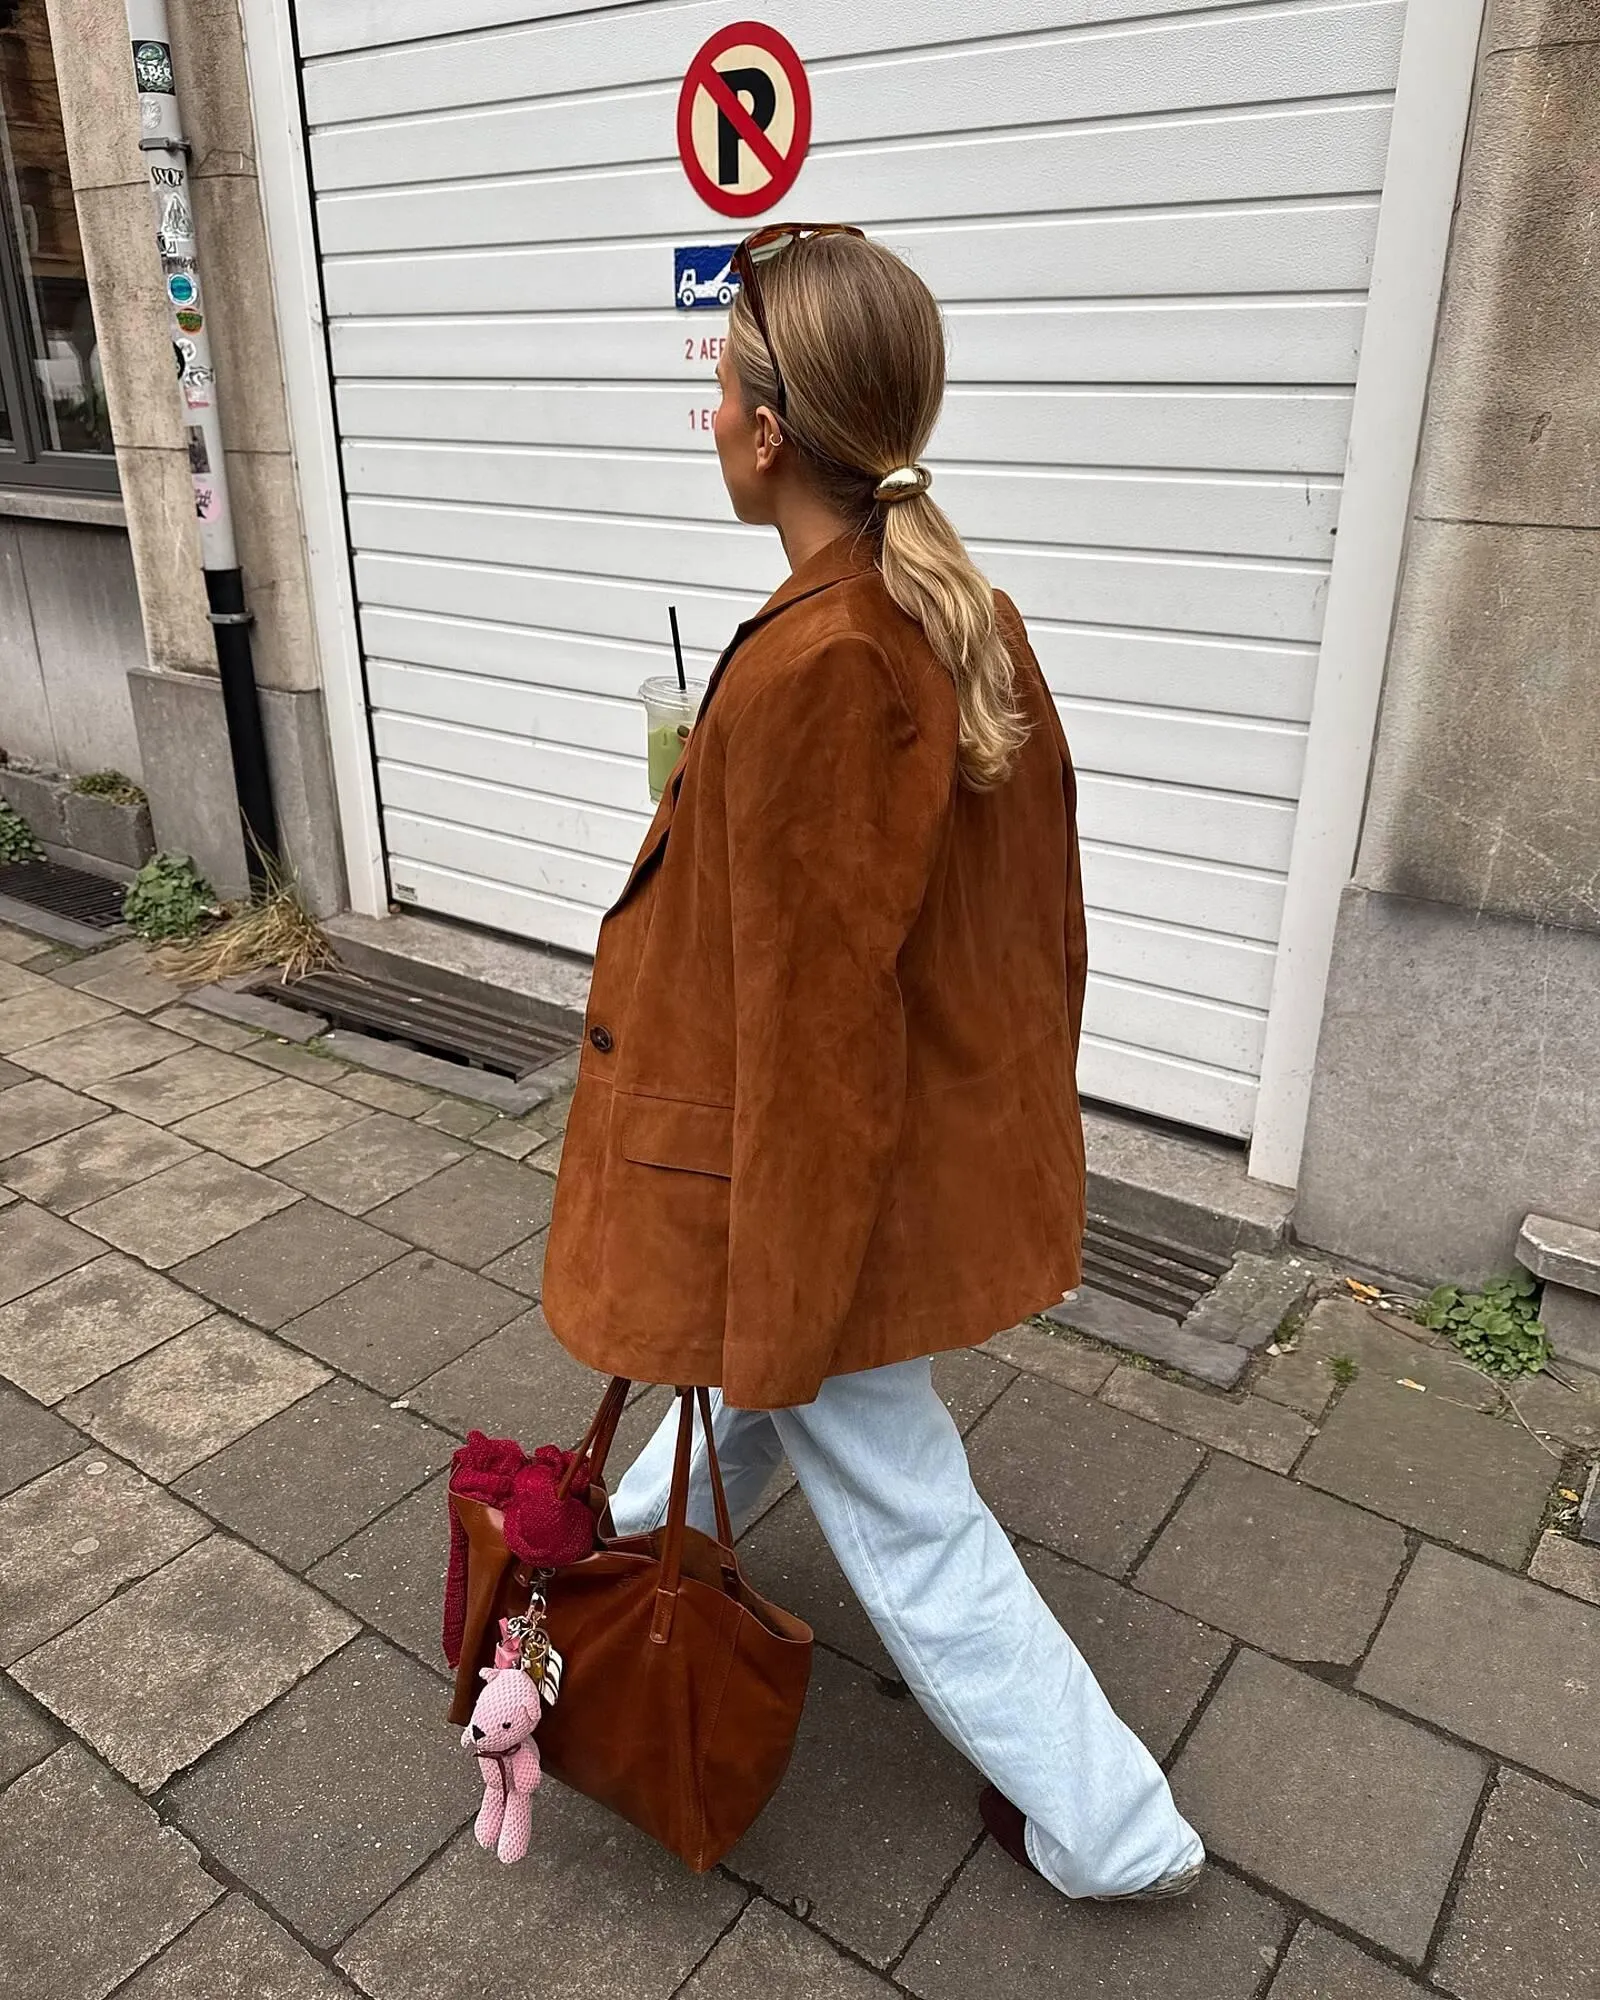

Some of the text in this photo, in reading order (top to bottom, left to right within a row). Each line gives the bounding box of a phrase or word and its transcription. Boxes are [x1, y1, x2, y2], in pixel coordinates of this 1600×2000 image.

[717, 67, 777, 186] P
[685, 338, 694, 360] 2
[688, 408, 696, 430] 1
